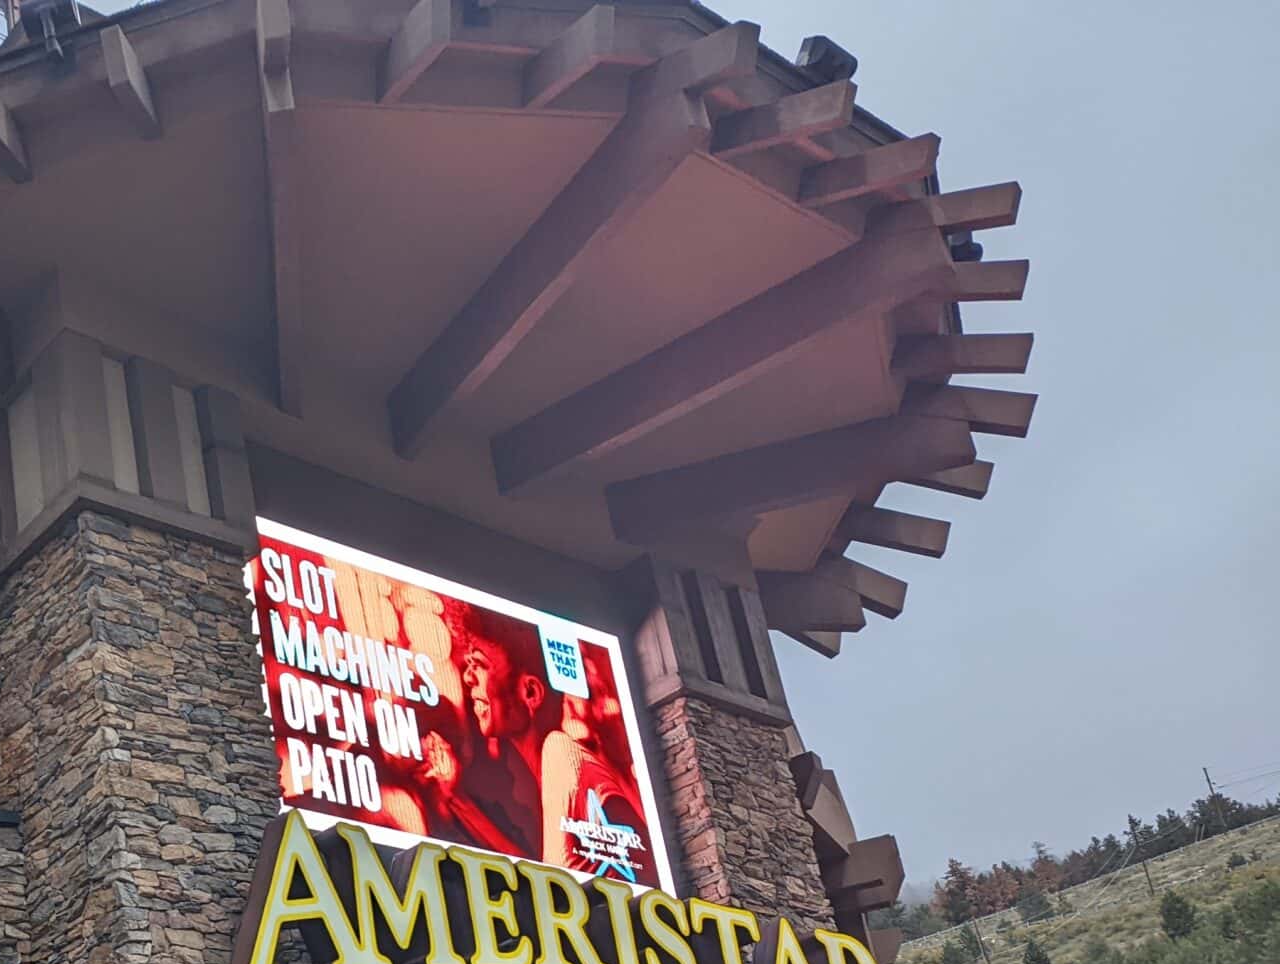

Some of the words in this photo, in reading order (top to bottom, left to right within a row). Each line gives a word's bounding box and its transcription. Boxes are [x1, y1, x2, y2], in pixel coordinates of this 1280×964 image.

[261, 547, 340, 619] SLOT
[269, 609, 439, 706] MACHINES
[546, 638, 575, 656] MEET
[550, 651, 576, 667] THAT
[555, 664, 577, 680] YOU
[278, 672, 369, 747] OPEN
[374, 697, 423, 761] ON
[286, 737, 382, 813] PATIO
[560, 816, 646, 851] AMERISTAR
